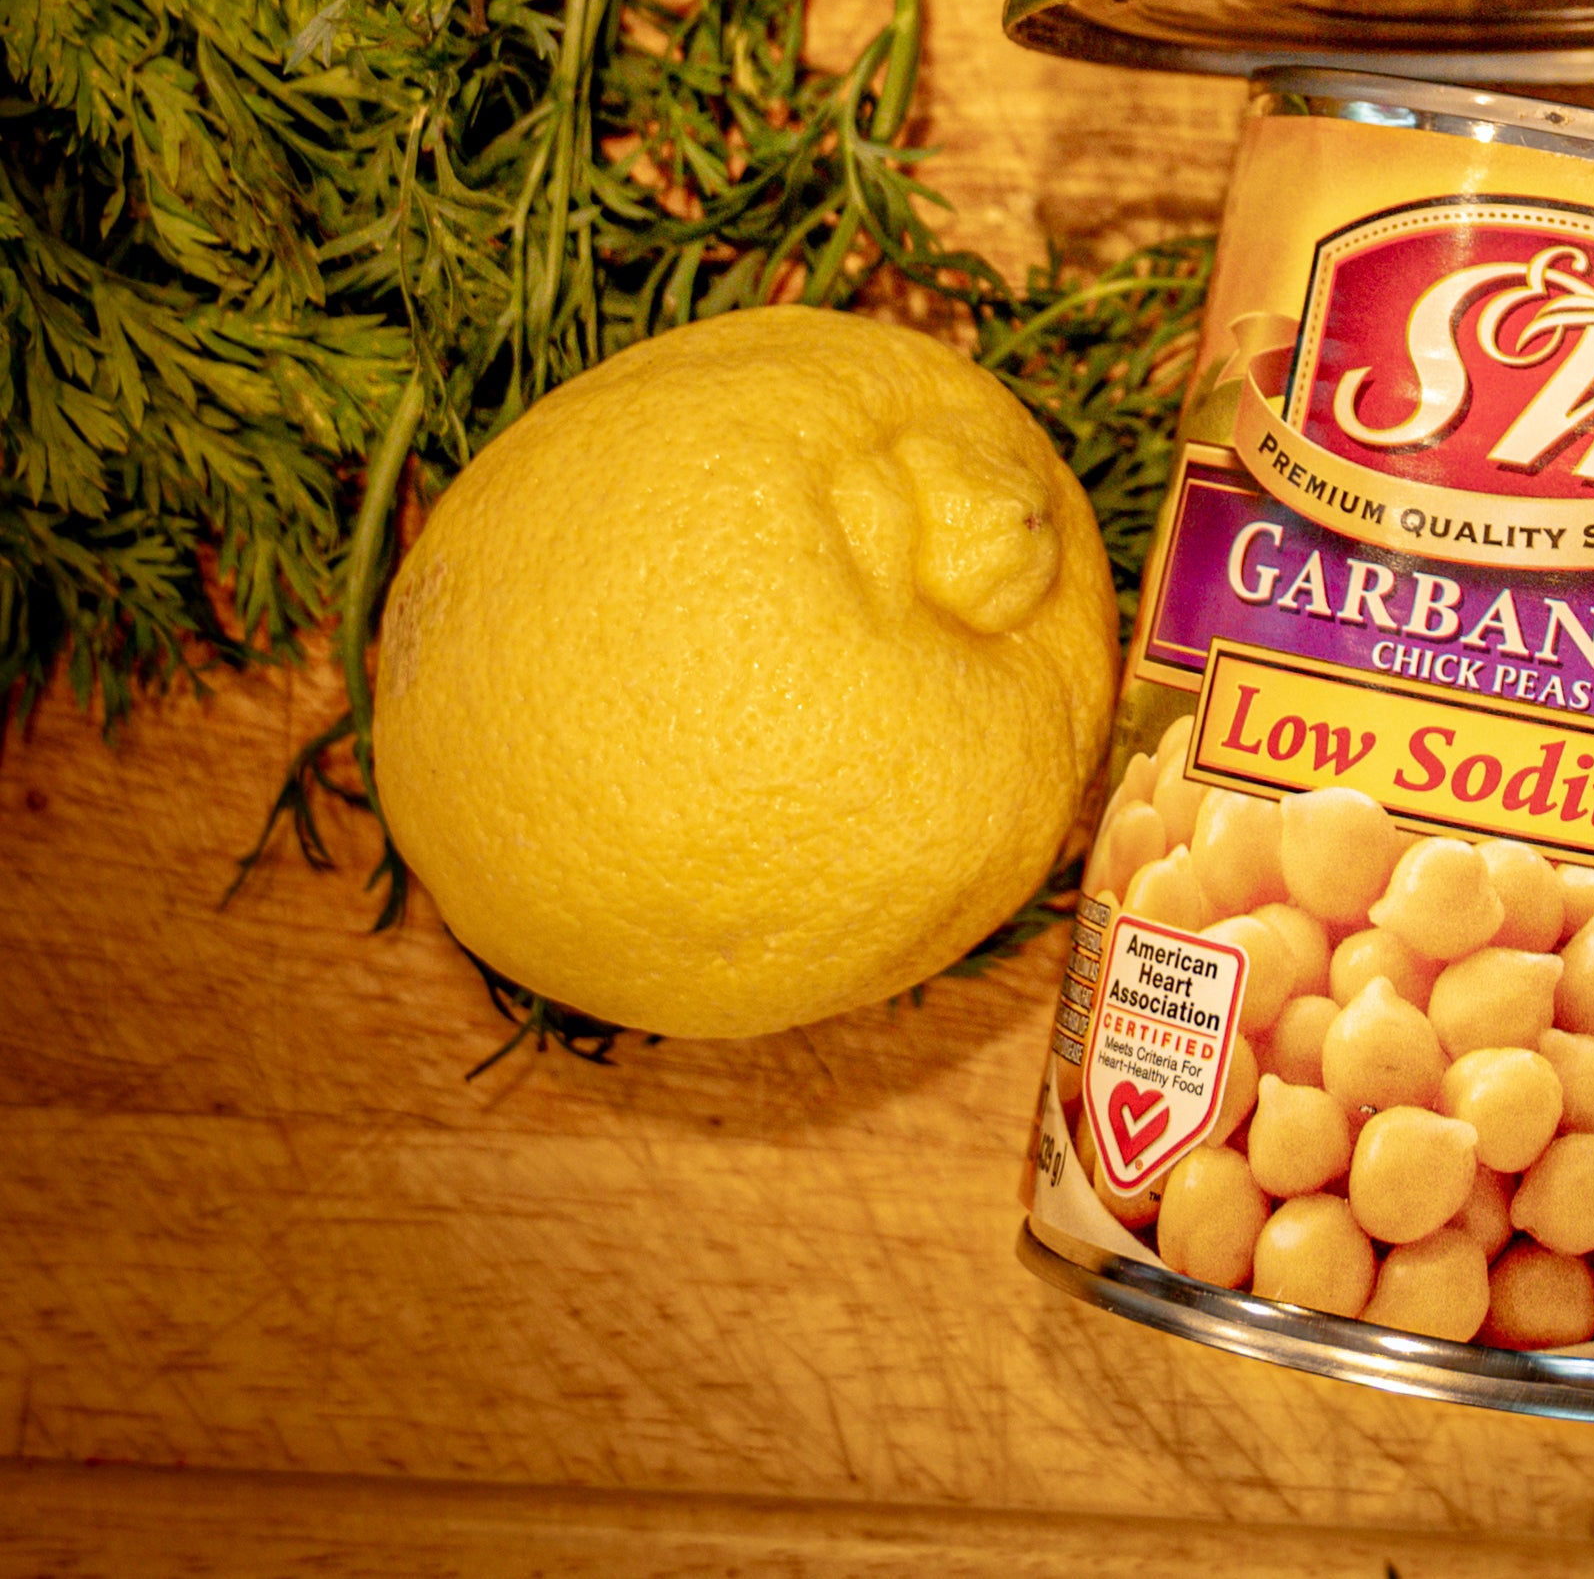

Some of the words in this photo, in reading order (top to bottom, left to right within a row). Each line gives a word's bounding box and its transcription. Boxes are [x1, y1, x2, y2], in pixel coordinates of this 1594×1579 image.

[1258, 431, 1387, 526] PREMIUM
[1400, 507, 1568, 551] QUALITY
[1370, 641, 1482, 694] CHICK
[1494, 667, 1593, 711] PEAS
[1220, 683, 1377, 777] Low
[1126, 933, 1219, 980] American
[1138, 962, 1193, 998] Heart
[1109, 978, 1221, 1032] Association
[1103, 1012, 1215, 1061] CERTIFIED
[1104, 1036, 1134, 1058] Meets
[1136, 1046, 1178, 1072] Criteria
[1181, 1060, 1203, 1078] For
[1097, 1051, 1170, 1089] Heart-Healthy
[1172, 1075, 1205, 1097] Food
